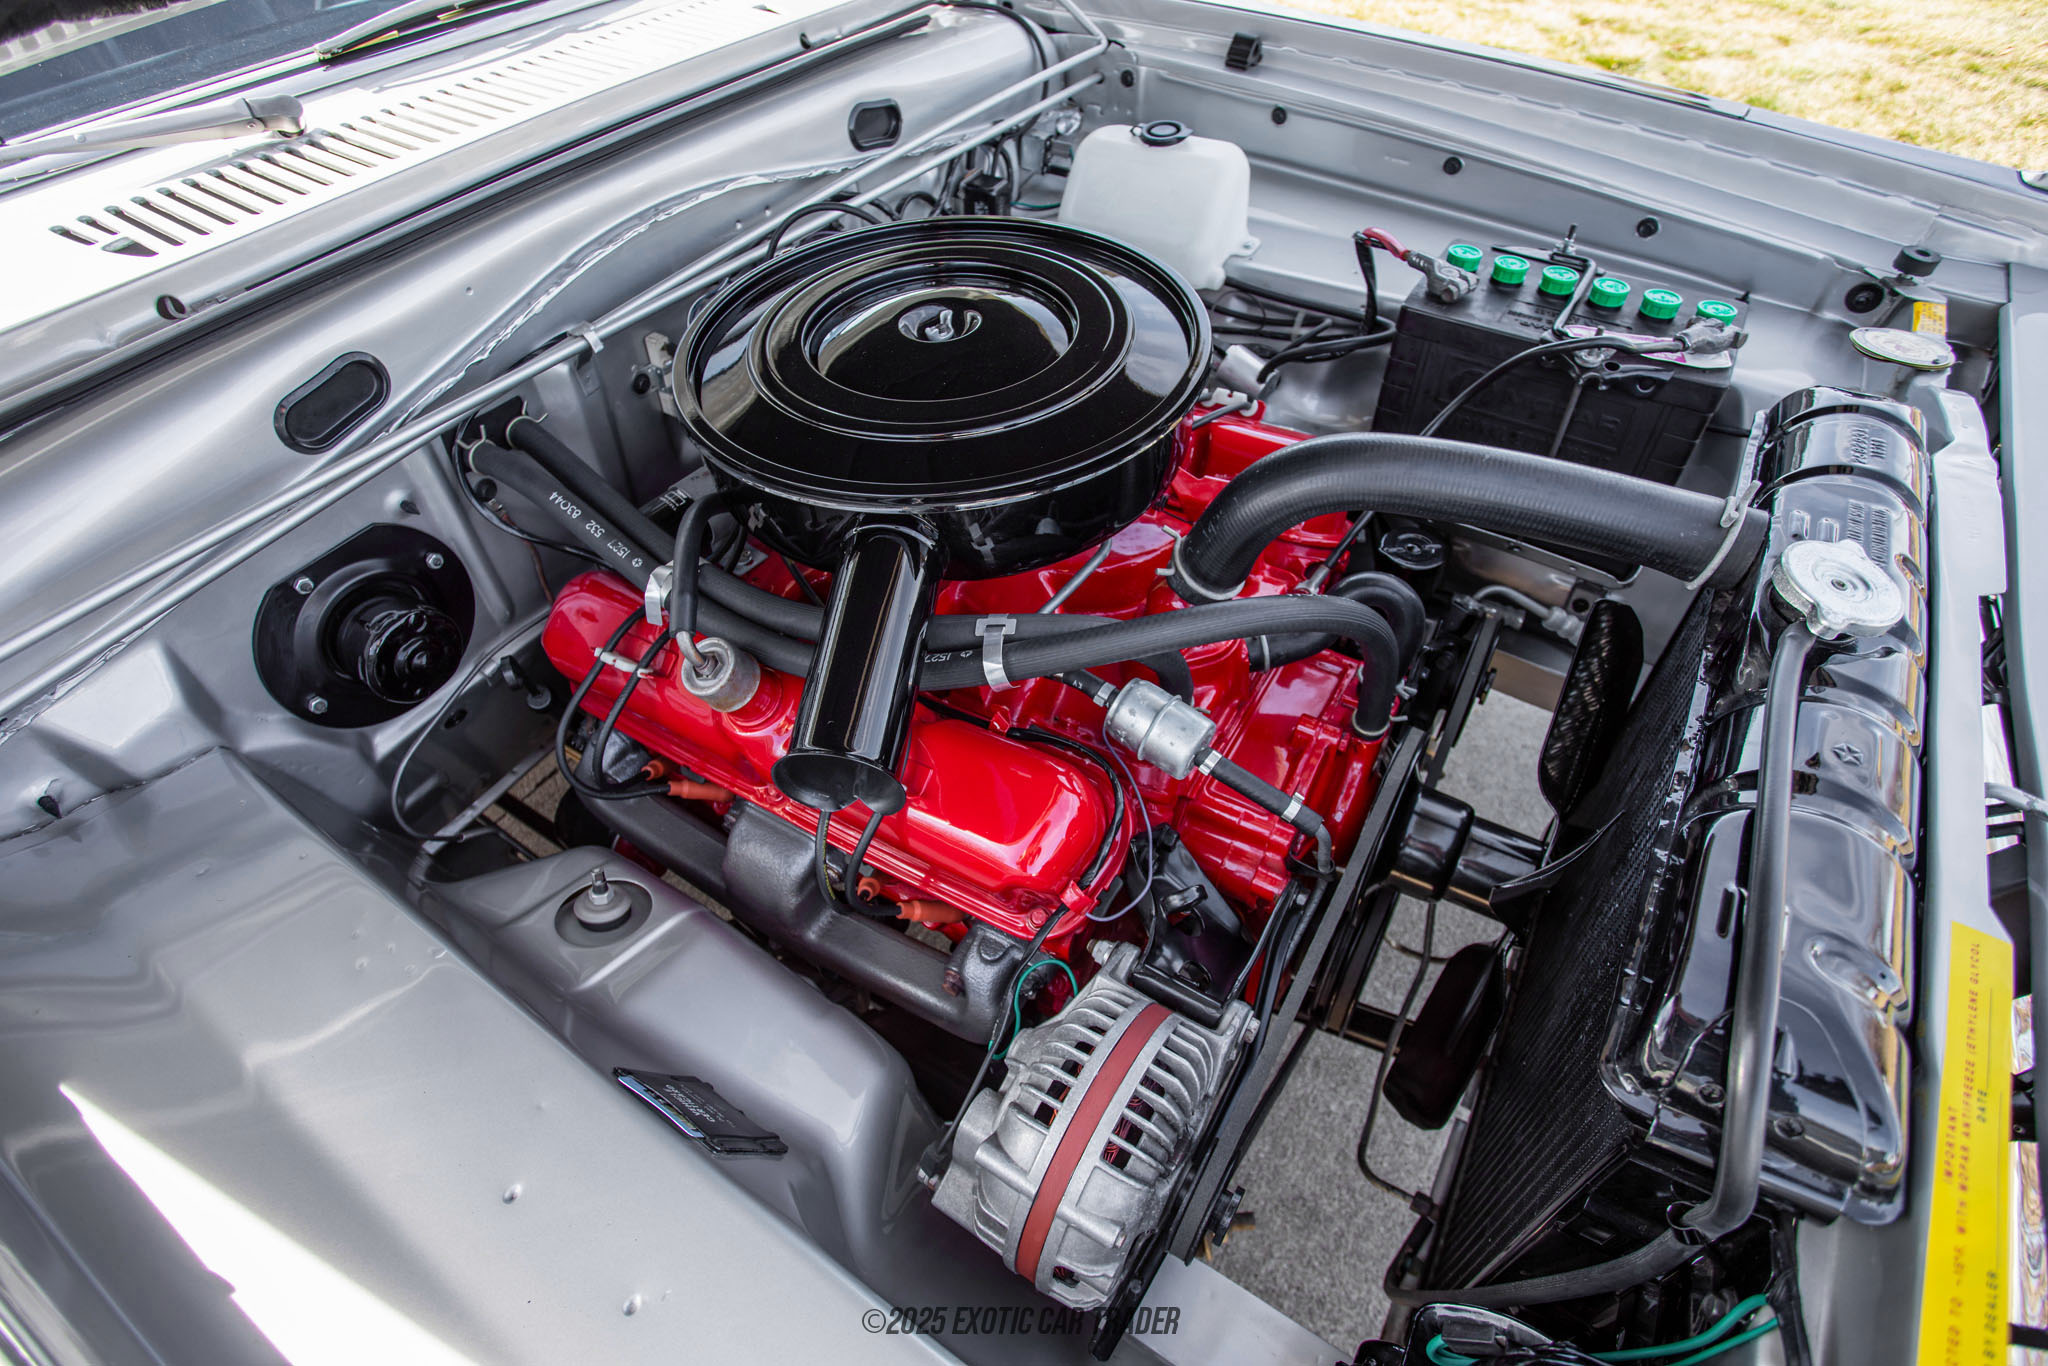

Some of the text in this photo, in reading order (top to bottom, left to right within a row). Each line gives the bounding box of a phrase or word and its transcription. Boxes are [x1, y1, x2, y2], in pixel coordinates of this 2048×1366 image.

[548, 490, 631, 559] 1527 532 83044
[1969, 943, 1980, 985] GLYCOL
[1961, 1059, 1976, 1138] ANTIFREEZE
[1976, 1088, 1987, 1124] DATE
[1942, 1105, 1958, 1184] IMPORTANT
[1957, 1145, 1971, 1193] MOPAR
[1983, 1270, 1998, 1333] DEALER
